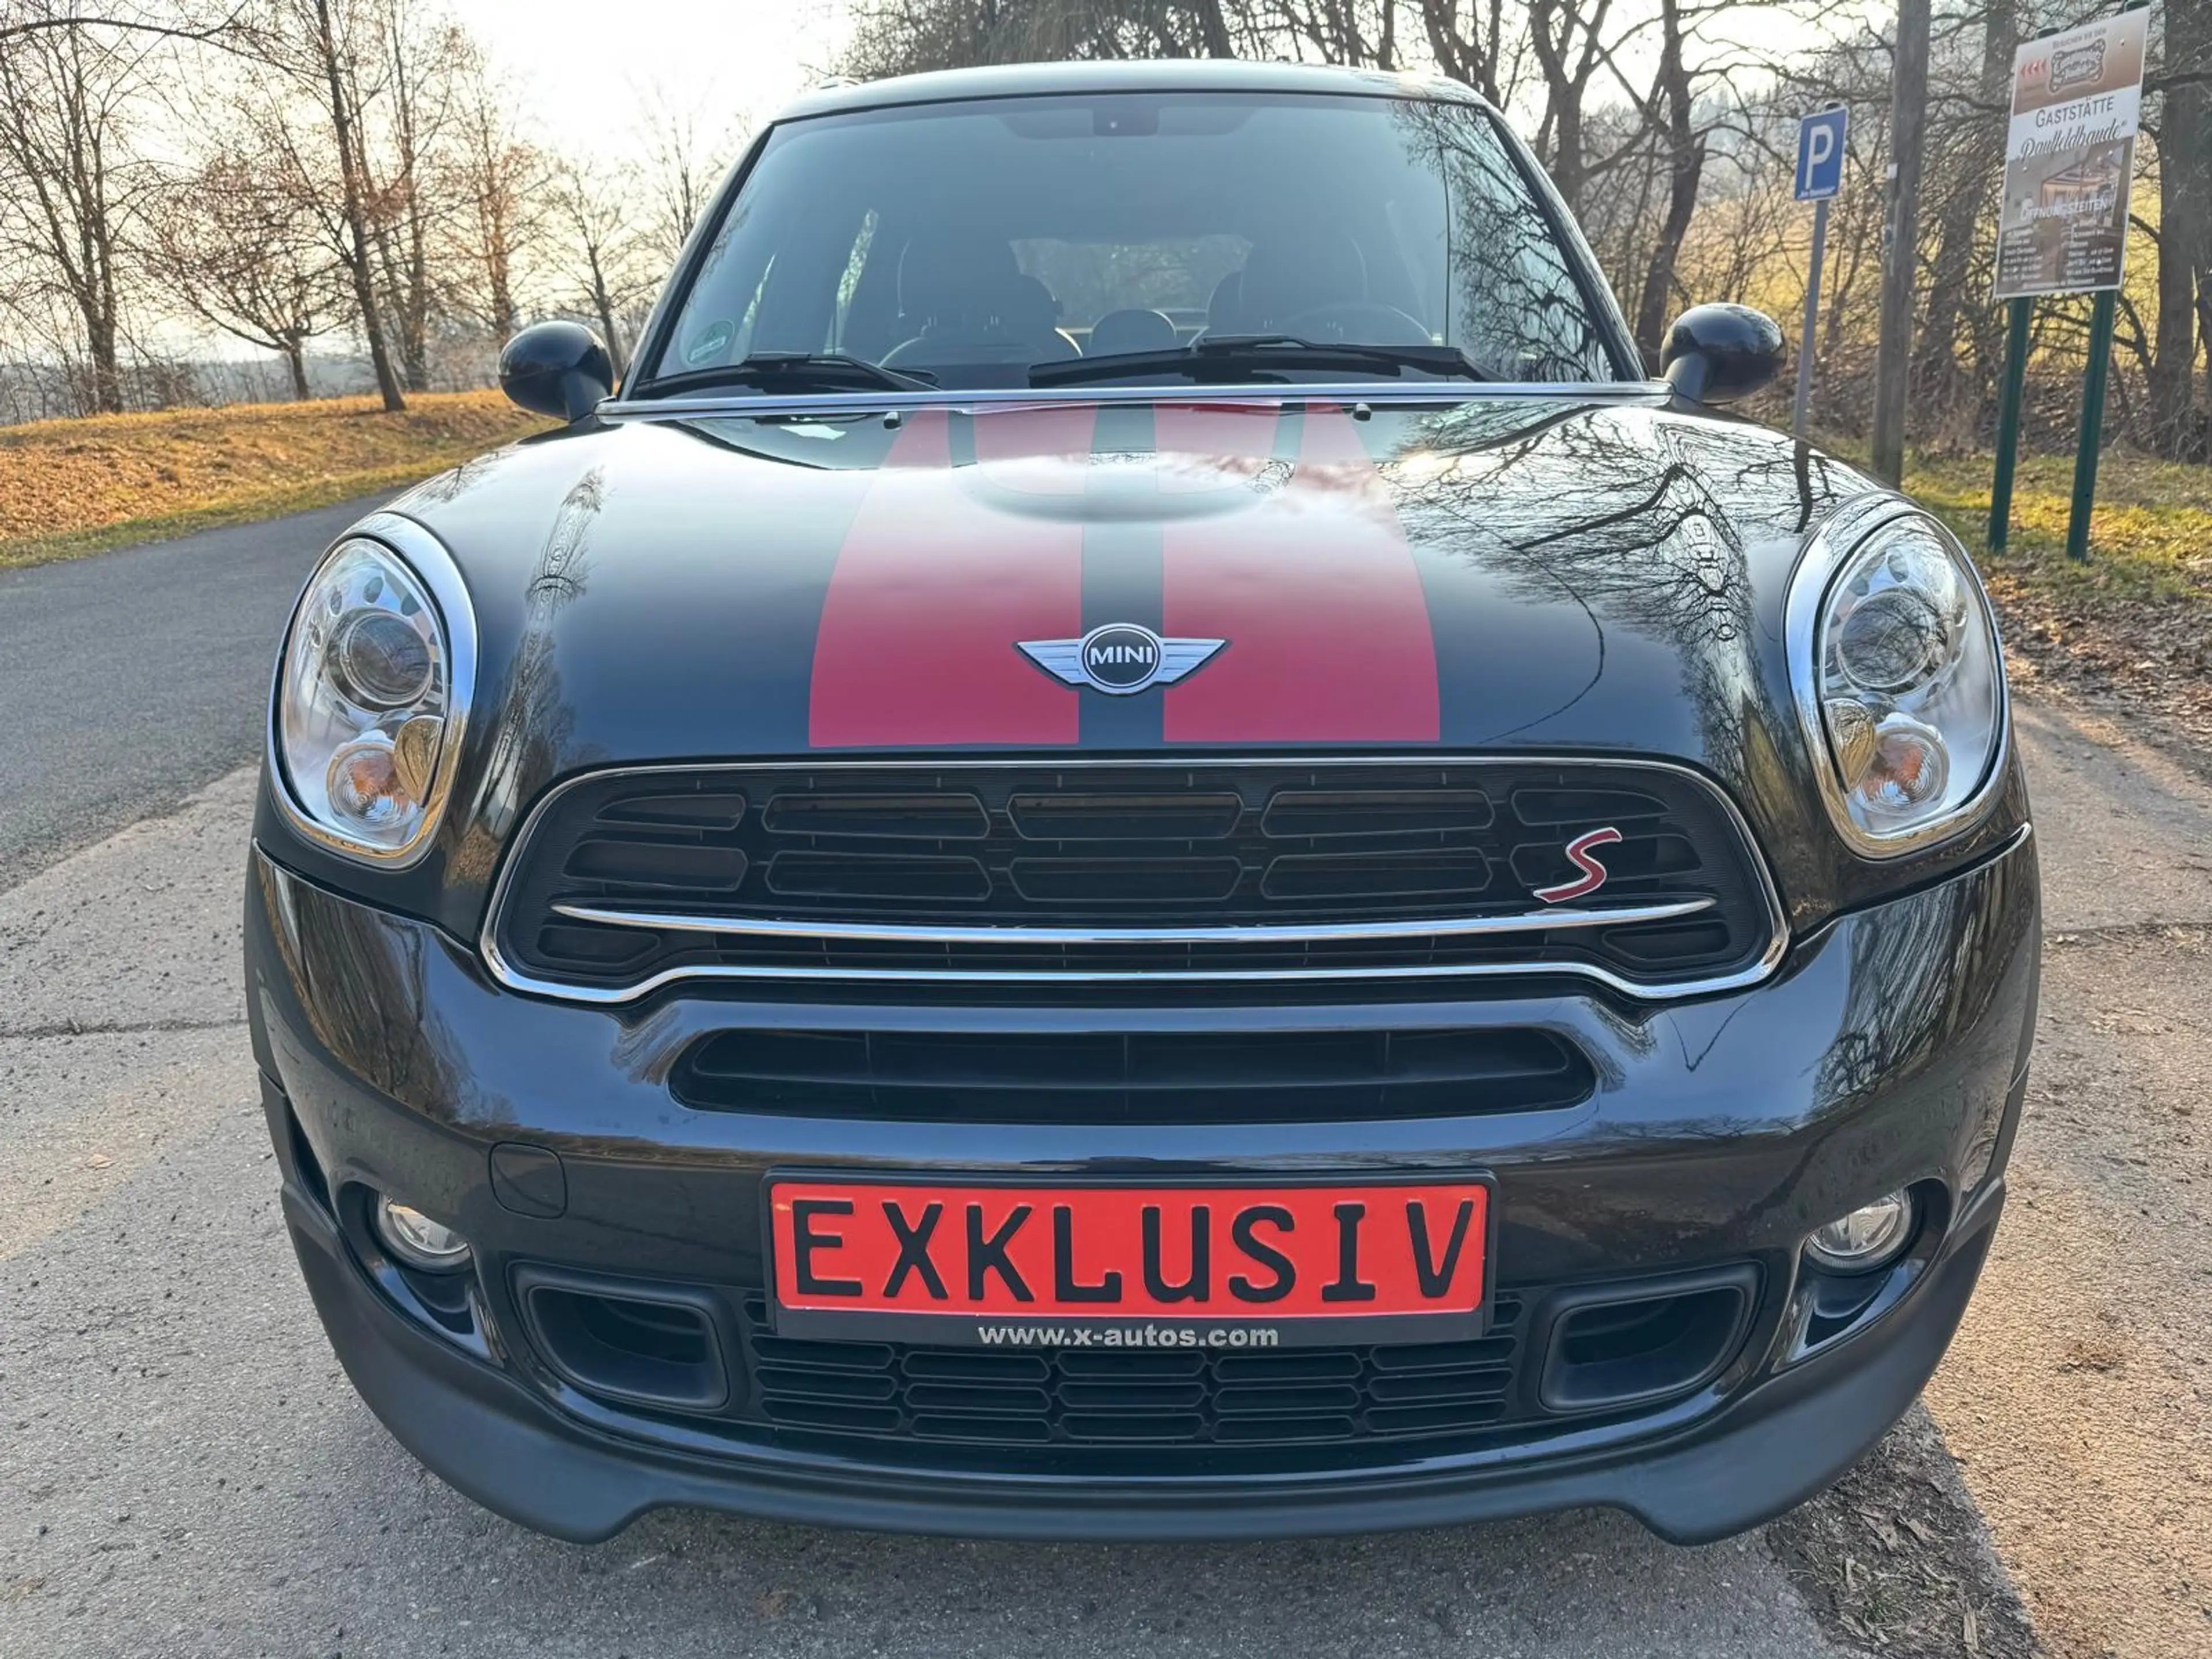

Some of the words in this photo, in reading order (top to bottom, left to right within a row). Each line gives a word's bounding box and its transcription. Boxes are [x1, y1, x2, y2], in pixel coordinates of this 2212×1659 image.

[2036, 96, 2115, 128] GASTSTÄTTE
[1805, 124, 1834, 189] P
[1090, 646, 1153, 665] MINI
[1533, 827, 1623, 903] S
[792, 1199, 1475, 1303] EXKLUSIV
[979, 1324, 1279, 1346] www.x-autos.com
